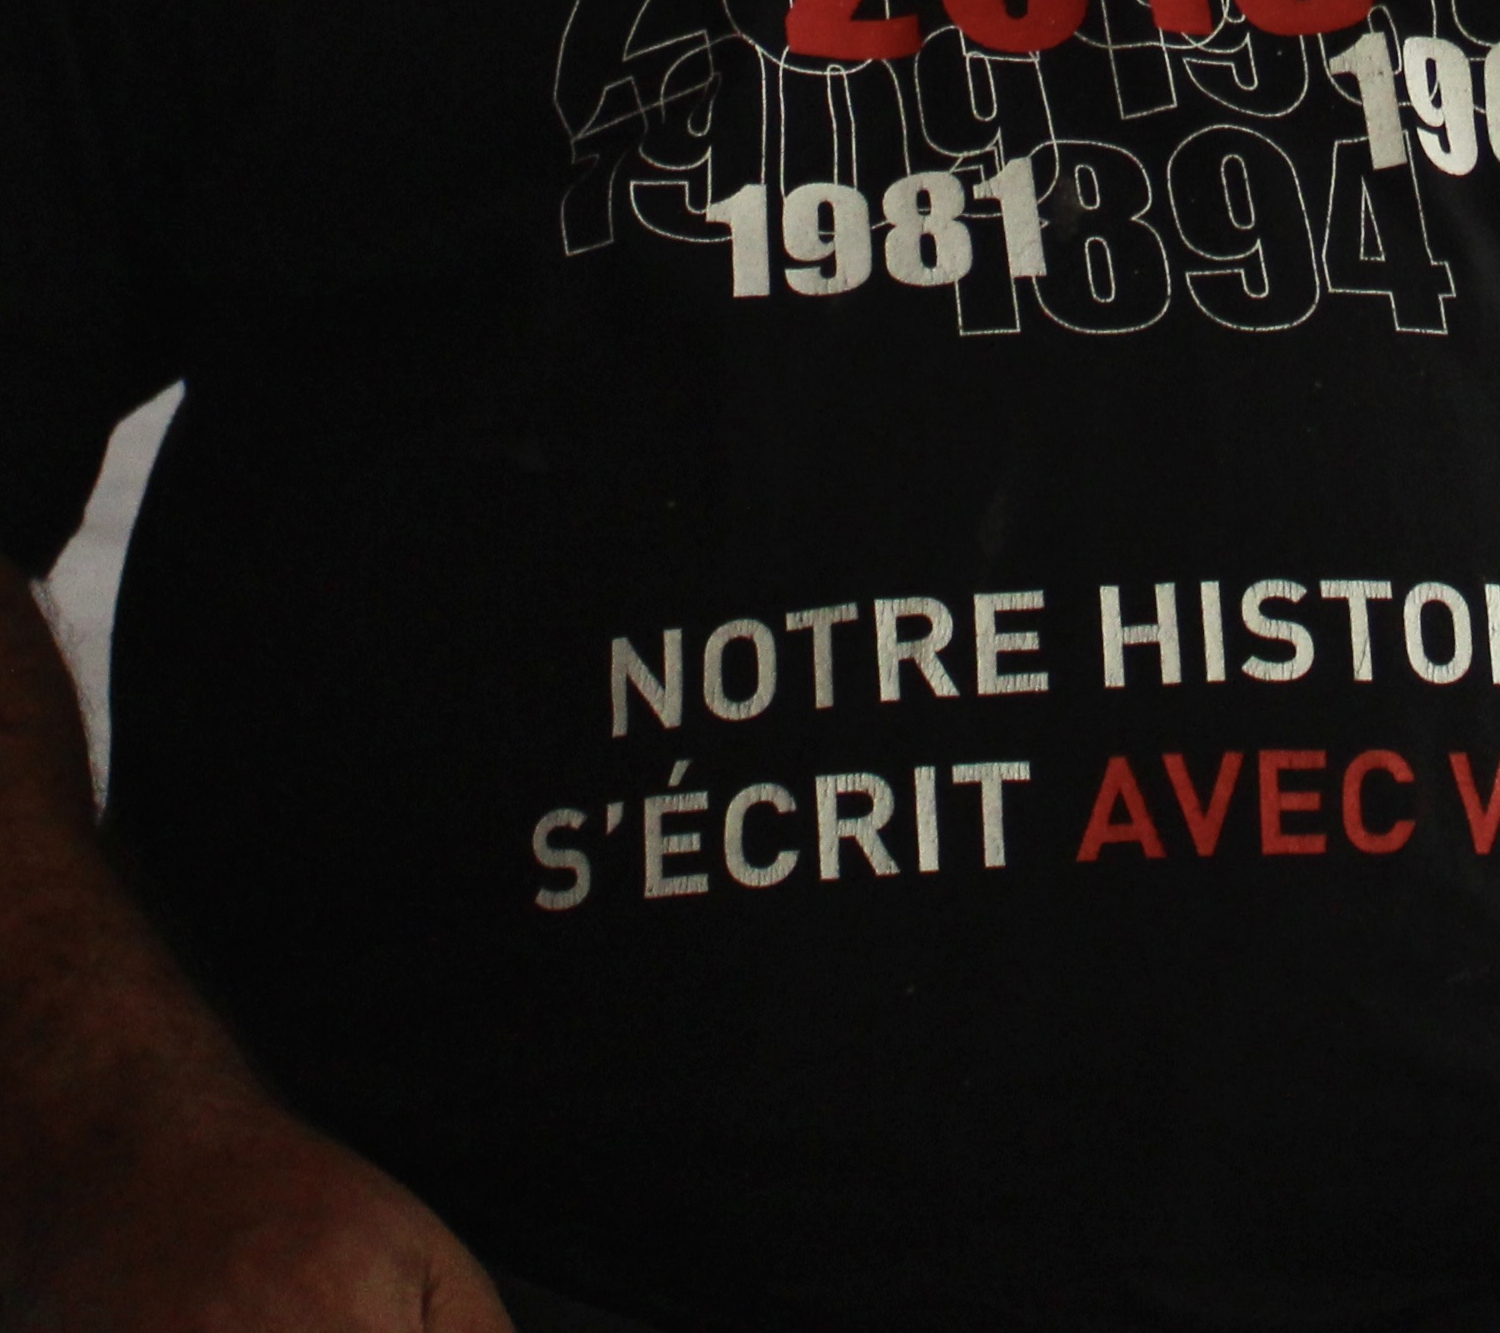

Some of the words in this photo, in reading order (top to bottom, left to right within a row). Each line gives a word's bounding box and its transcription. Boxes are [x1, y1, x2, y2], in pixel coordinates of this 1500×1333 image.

[706, 156, 1047, 298] 1981
[611, 589, 1049, 737] NOTRE
[532, 759, 1031, 910] S'ÉCRIT
[1076, 749, 1416, 861] AVEC
